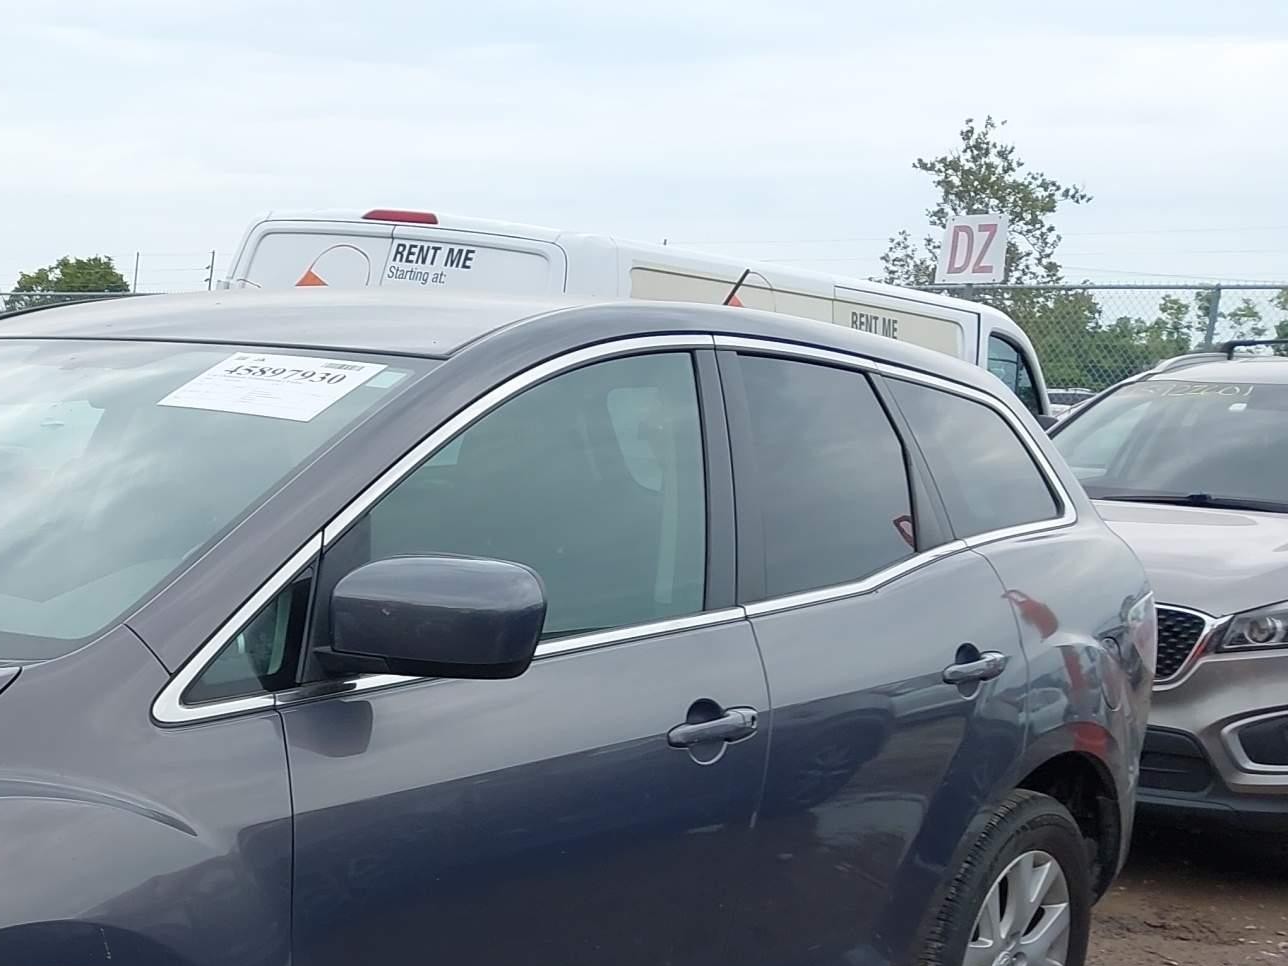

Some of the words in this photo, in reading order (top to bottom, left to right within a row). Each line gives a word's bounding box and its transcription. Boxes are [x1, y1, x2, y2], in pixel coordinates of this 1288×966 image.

[392, 243, 442, 266] RENT
[443, 247, 476, 270] ME
[946, 223, 998, 275] DZ
[386, 265, 430, 286] Starting
[431, 270, 447, 284] at:
[850, 311, 880, 335] RENT
[881, 316, 898, 340] ME
[223, 364, 347, 385] 45897930
